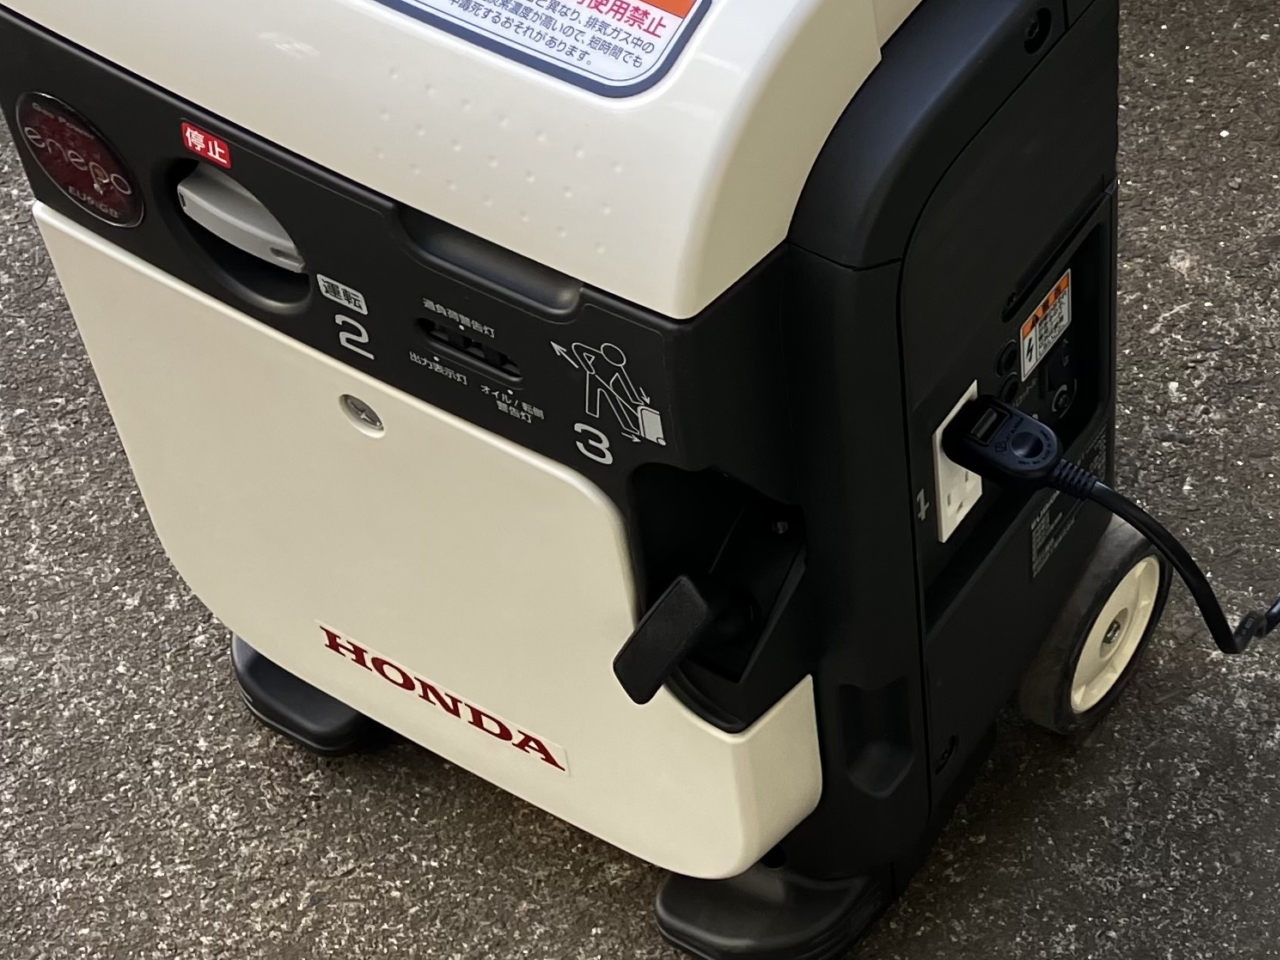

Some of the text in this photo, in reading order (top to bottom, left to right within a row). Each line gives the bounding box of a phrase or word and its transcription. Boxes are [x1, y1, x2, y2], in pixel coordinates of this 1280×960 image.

[185, 127, 227, 164] 停止
[334, 314, 375, 360] 2
[574, 423, 613, 465] 3
[319, 625, 565, 771] HONDA
